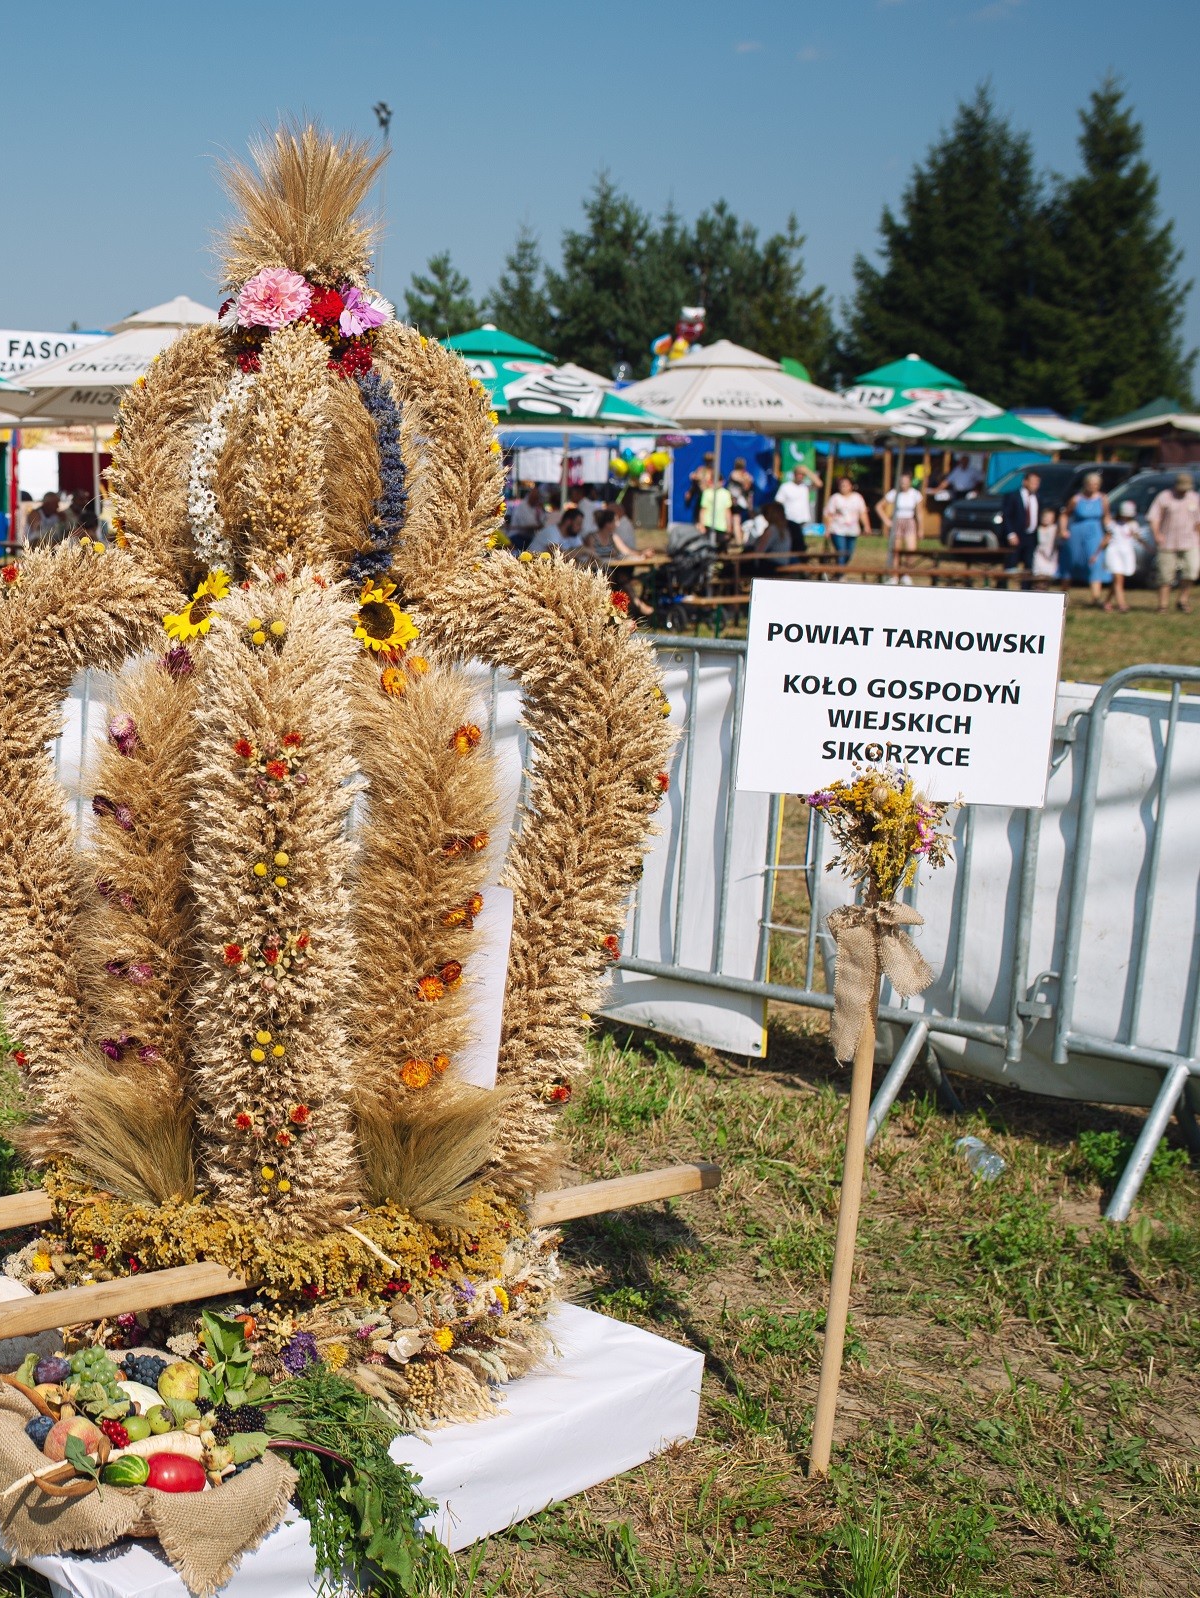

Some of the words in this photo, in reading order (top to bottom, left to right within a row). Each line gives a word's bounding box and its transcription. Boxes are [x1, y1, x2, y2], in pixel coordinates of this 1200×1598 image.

[68, 362, 146, 372] OKOCI
[702, 397, 784, 408] OKOCIM
[767, 622, 874, 647] POWIAT
[882, 627, 1046, 655] TARNOWSKI
[783, 674, 858, 697] KOŁO
[867, 678, 1021, 705] GOSPODYŃ
[827, 708, 972, 735] WIEJSKICH
[821, 740, 971, 767] SIKORZYCE
